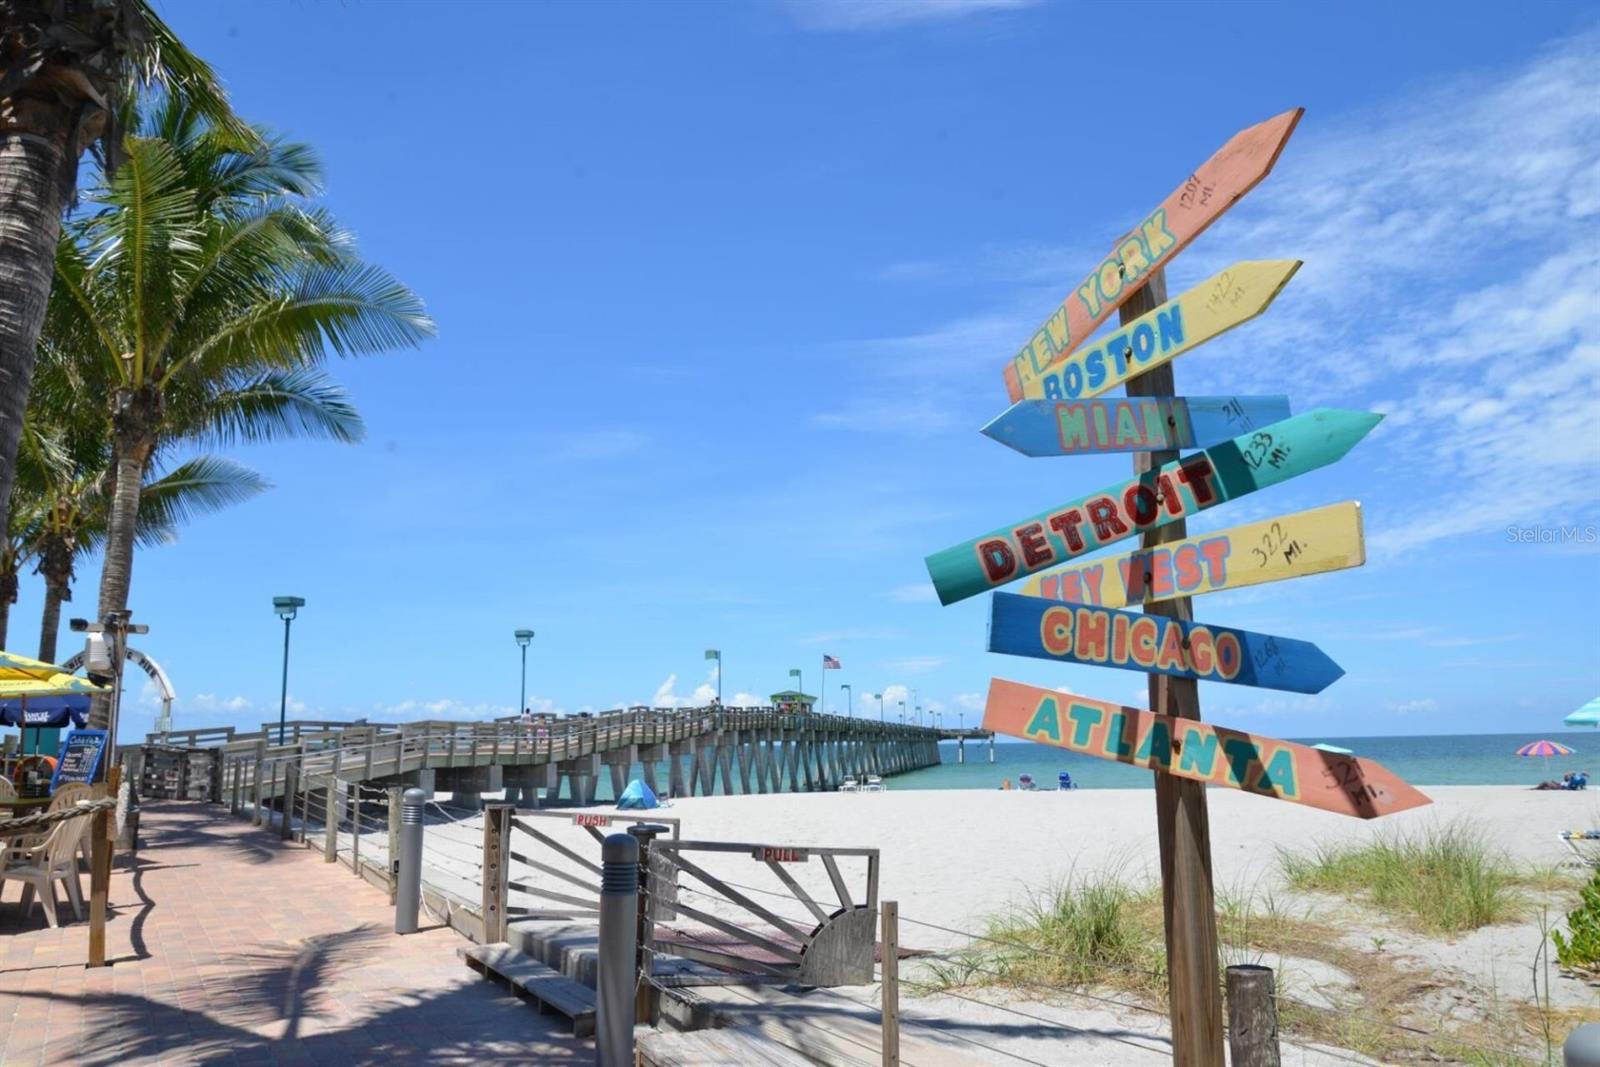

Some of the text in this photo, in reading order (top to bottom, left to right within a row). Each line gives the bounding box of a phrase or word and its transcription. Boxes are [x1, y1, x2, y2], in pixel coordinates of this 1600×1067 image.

[1014, 207, 1177, 386] NEW YORK
[1041, 302, 1188, 400] BOSTON
[1055, 402, 1192, 452] MIAMI
[1242, 432, 1273, 471] 1233
[977, 454, 1221, 585] DETROIT
[1251, 521, 1288, 569] 322
[1040, 535, 1231, 606] KEY WEST
[1040, 606, 1242, 681] CHICAGO
[1023, 695, 1300, 800] ATLANTA
[1321, 757, 1365, 790] 521
[577, 814, 608, 826] PUSH
[762, 848, 800, 862] PULL
